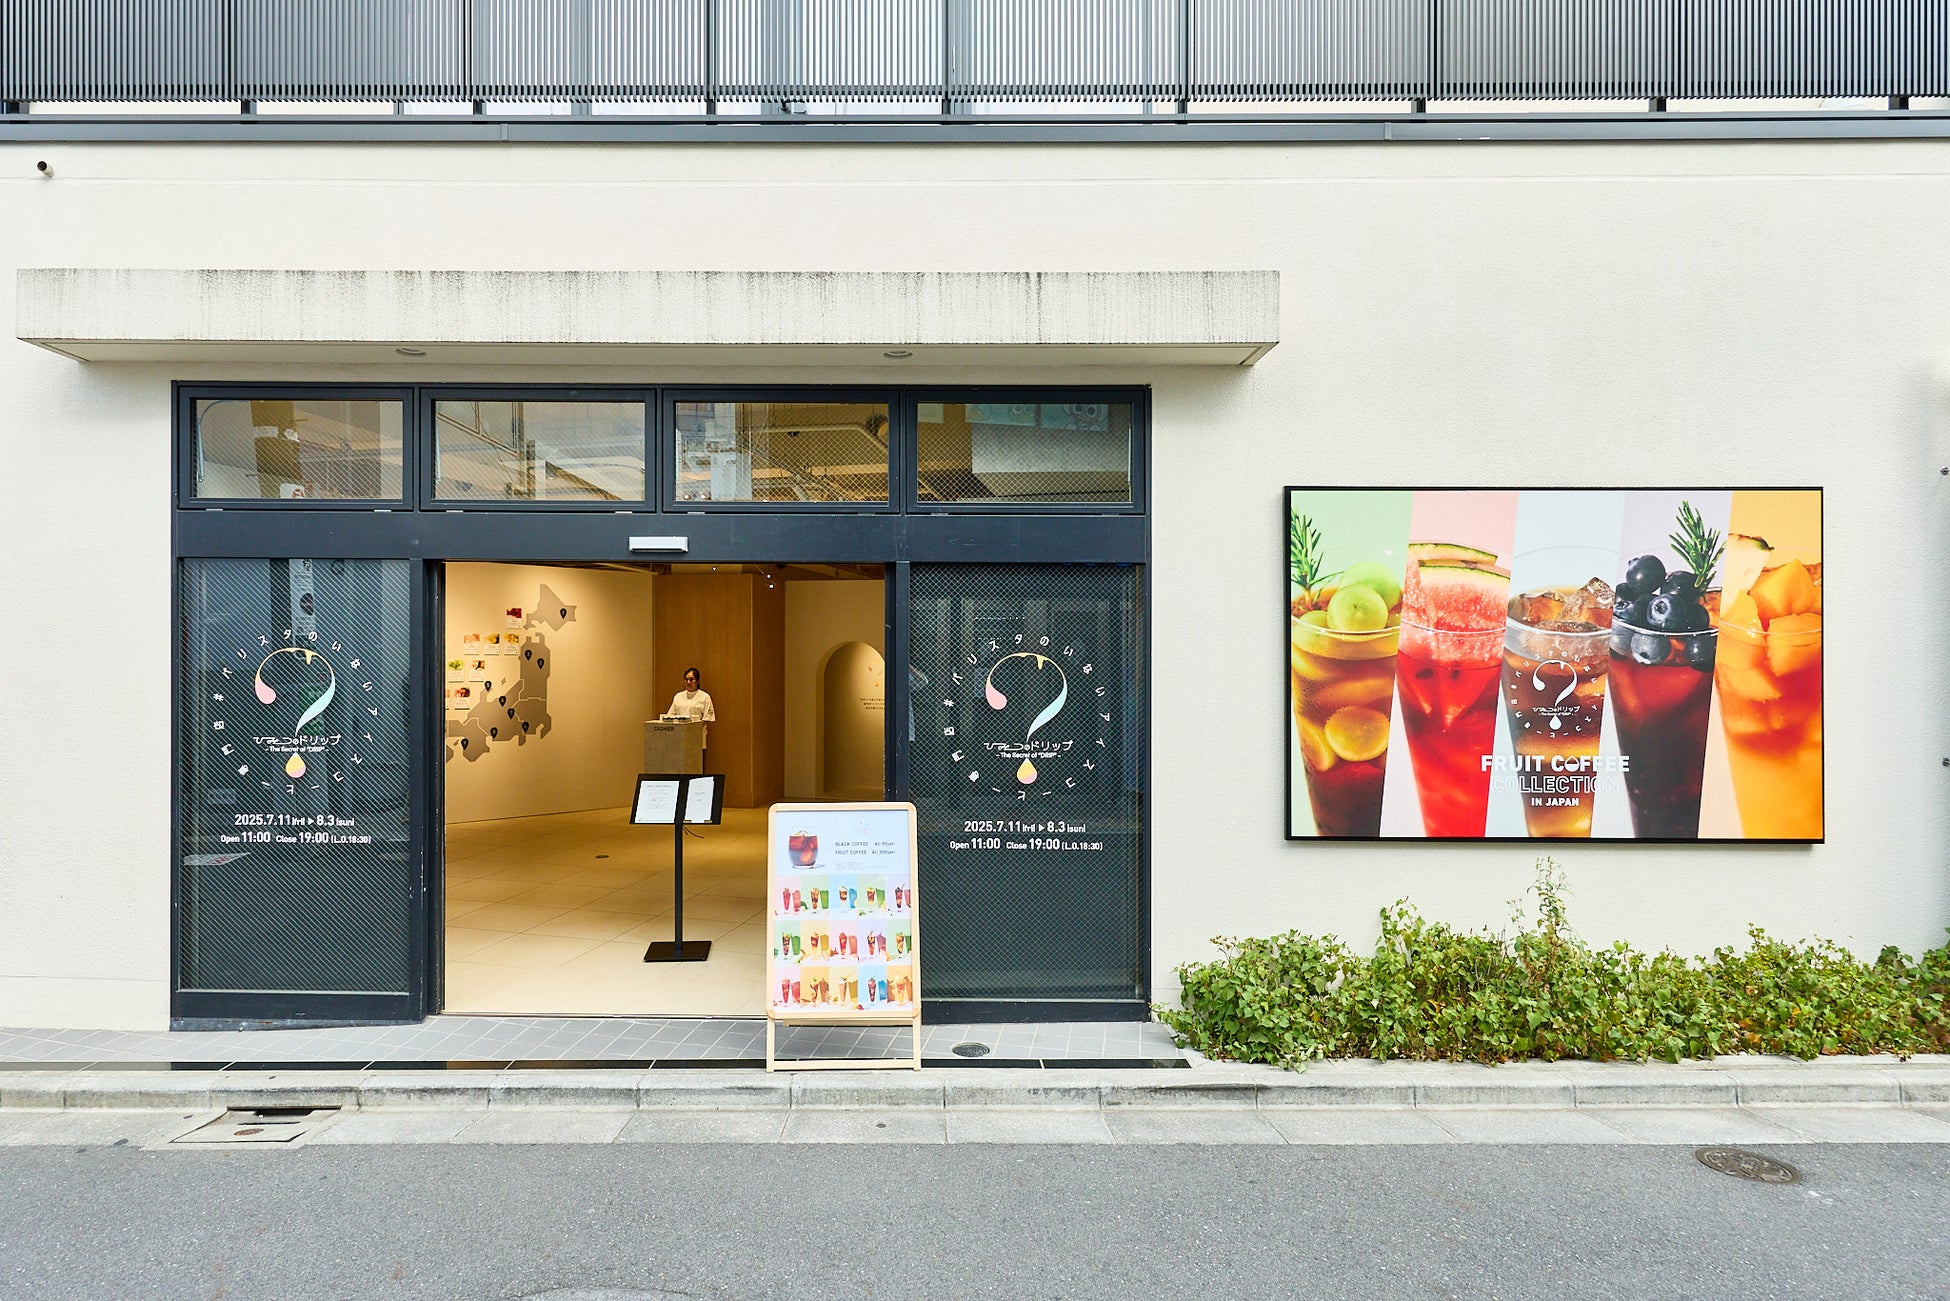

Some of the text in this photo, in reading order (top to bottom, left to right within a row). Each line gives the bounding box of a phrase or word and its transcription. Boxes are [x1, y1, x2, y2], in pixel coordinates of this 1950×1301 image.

[1481, 755, 1630, 772] FRUIT COFFEE
[1492, 776, 1620, 794] COLLECTION
[1531, 797, 1579, 806] IN JAPAN
[234, 814, 291, 826] 2025.7.11
[316, 814, 334, 826] 8.3
[964, 821, 1021, 832] 2025.7.11
[1047, 821, 1065, 832] 8.3
[220, 834, 240, 844] Open
[241, 832, 270, 843] 11:00
[276, 834, 297, 843] Close
[299, 832, 329, 843] 19:00
[950, 841, 969, 850] Open
[971, 838, 1000, 849] 11:00
[1029, 838, 1060, 850] 19:00
